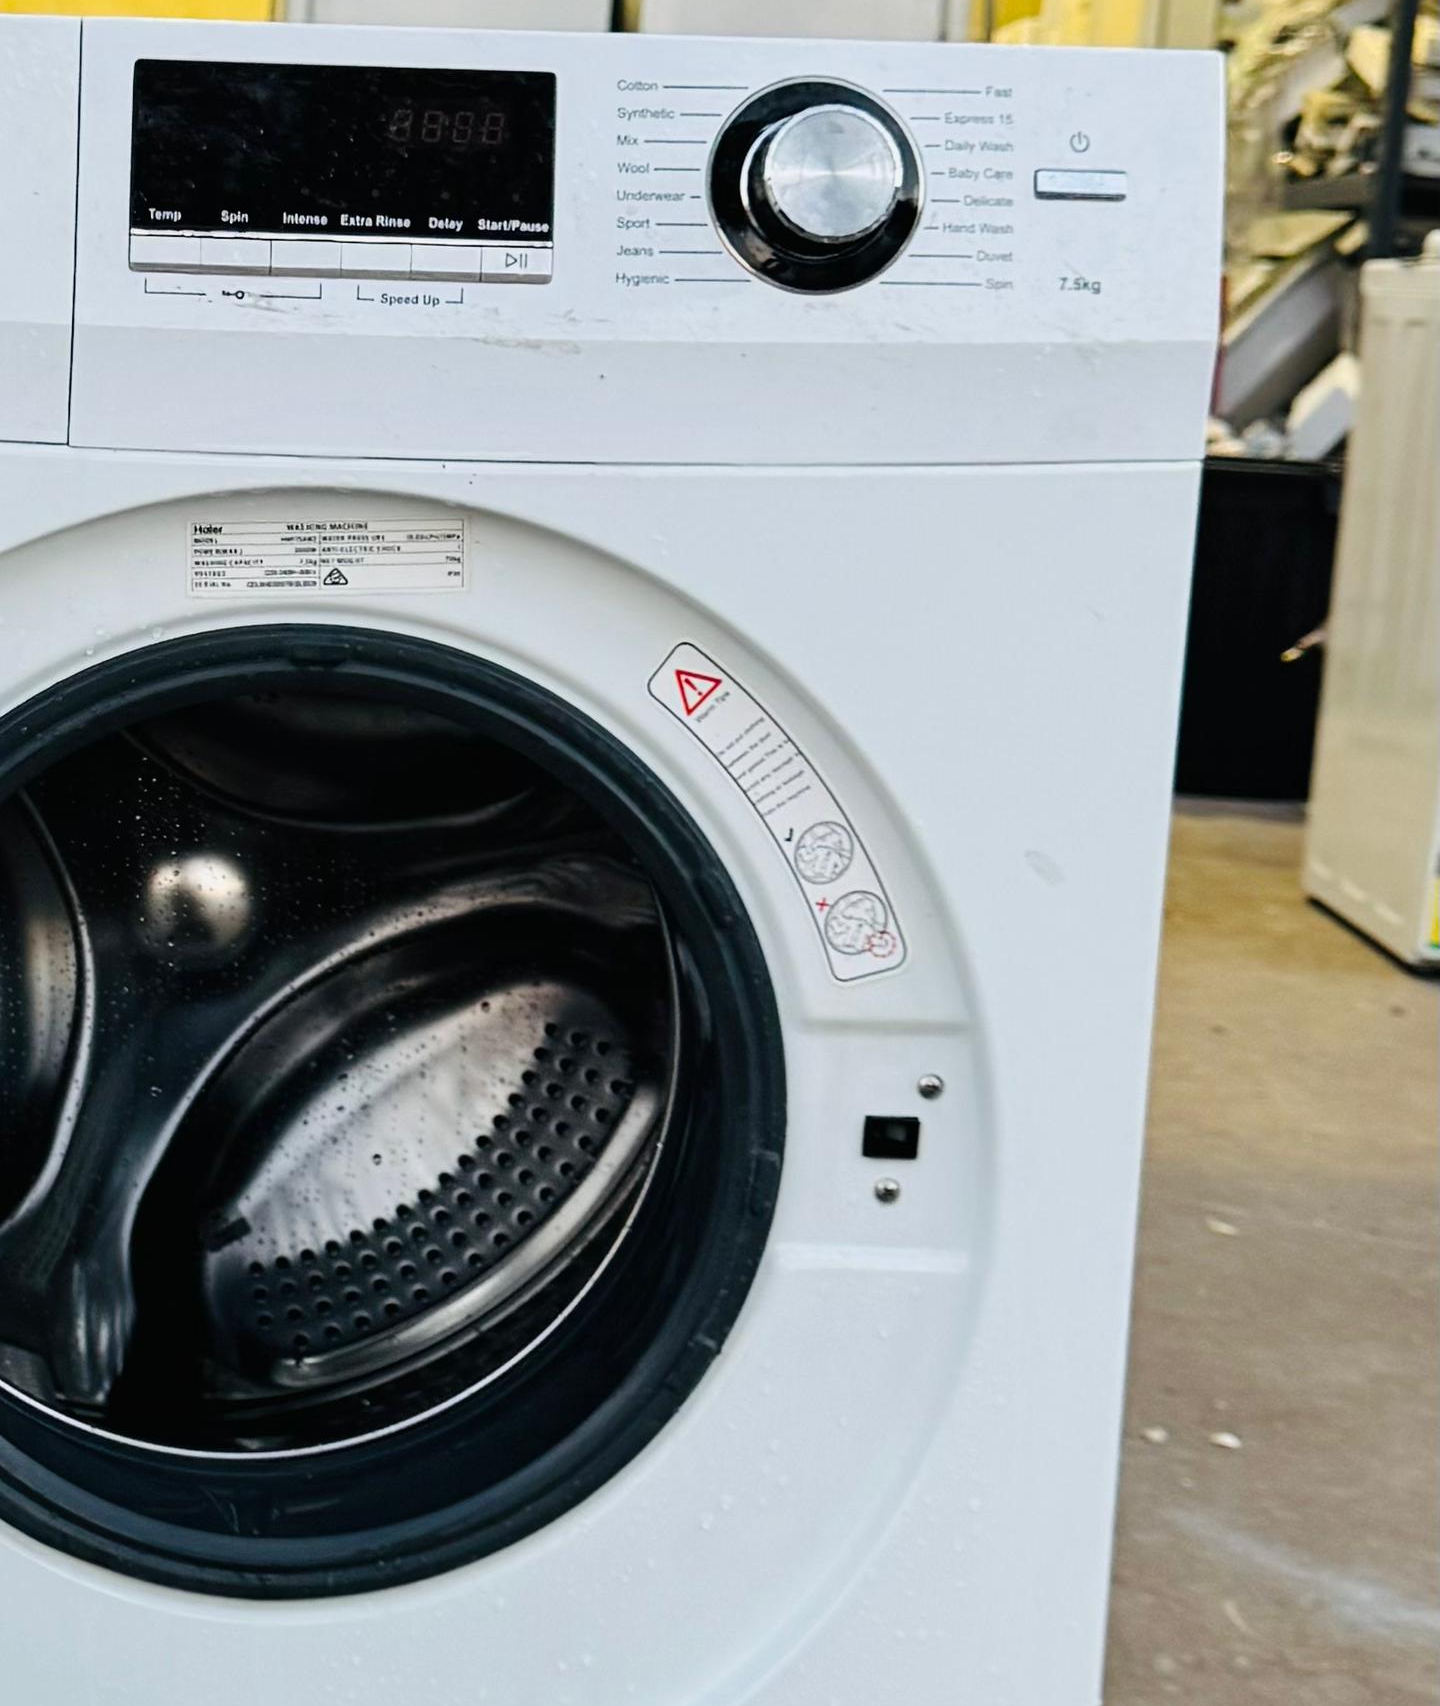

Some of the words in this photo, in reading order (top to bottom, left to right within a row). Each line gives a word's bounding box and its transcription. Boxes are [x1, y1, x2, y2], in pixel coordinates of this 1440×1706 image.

[616, 79, 658, 92] Cotton
[985, 86, 1013, 98] Fast
[616, 107, 675, 121] Synthetic
[944, 112, 994, 126] Express
[999, 114, 1014, 125] 15
[616, 134, 639, 145] Mix
[944, 139, 975, 153] Daily
[979, 141, 1014, 152] Wash
[617, 162, 650, 174] Wool
[948, 167, 980, 181] Baby
[983, 168, 1014, 180] Care
[616, 189, 685, 202] Underwear
[963, 195, 1014, 207] Delicate
[148, 208, 182, 222] Temp
[221, 209, 249, 223] Spin
[282, 212, 329, 226] Intense
[340, 214, 373, 227] Extra
[376, 215, 411, 228] Rinse
[428, 217, 464, 232] Delay
[477, 219, 550, 233] Start/Pause
[616, 217, 650, 230] Sport
[942, 223, 976, 234] Hand
[979, 223, 1014, 234] Wash
[616, 245, 654, 257] Jeans
[976, 250, 1013, 262] Duvet
[615, 273, 670, 286] Hygienic
[984, 278, 1013, 290] Spin
[1058, 277, 1102, 294] 7.5kg
[380, 293, 419, 306] Speed
[423, 295, 441, 307] Up
[193, 524, 223, 535] Haier
